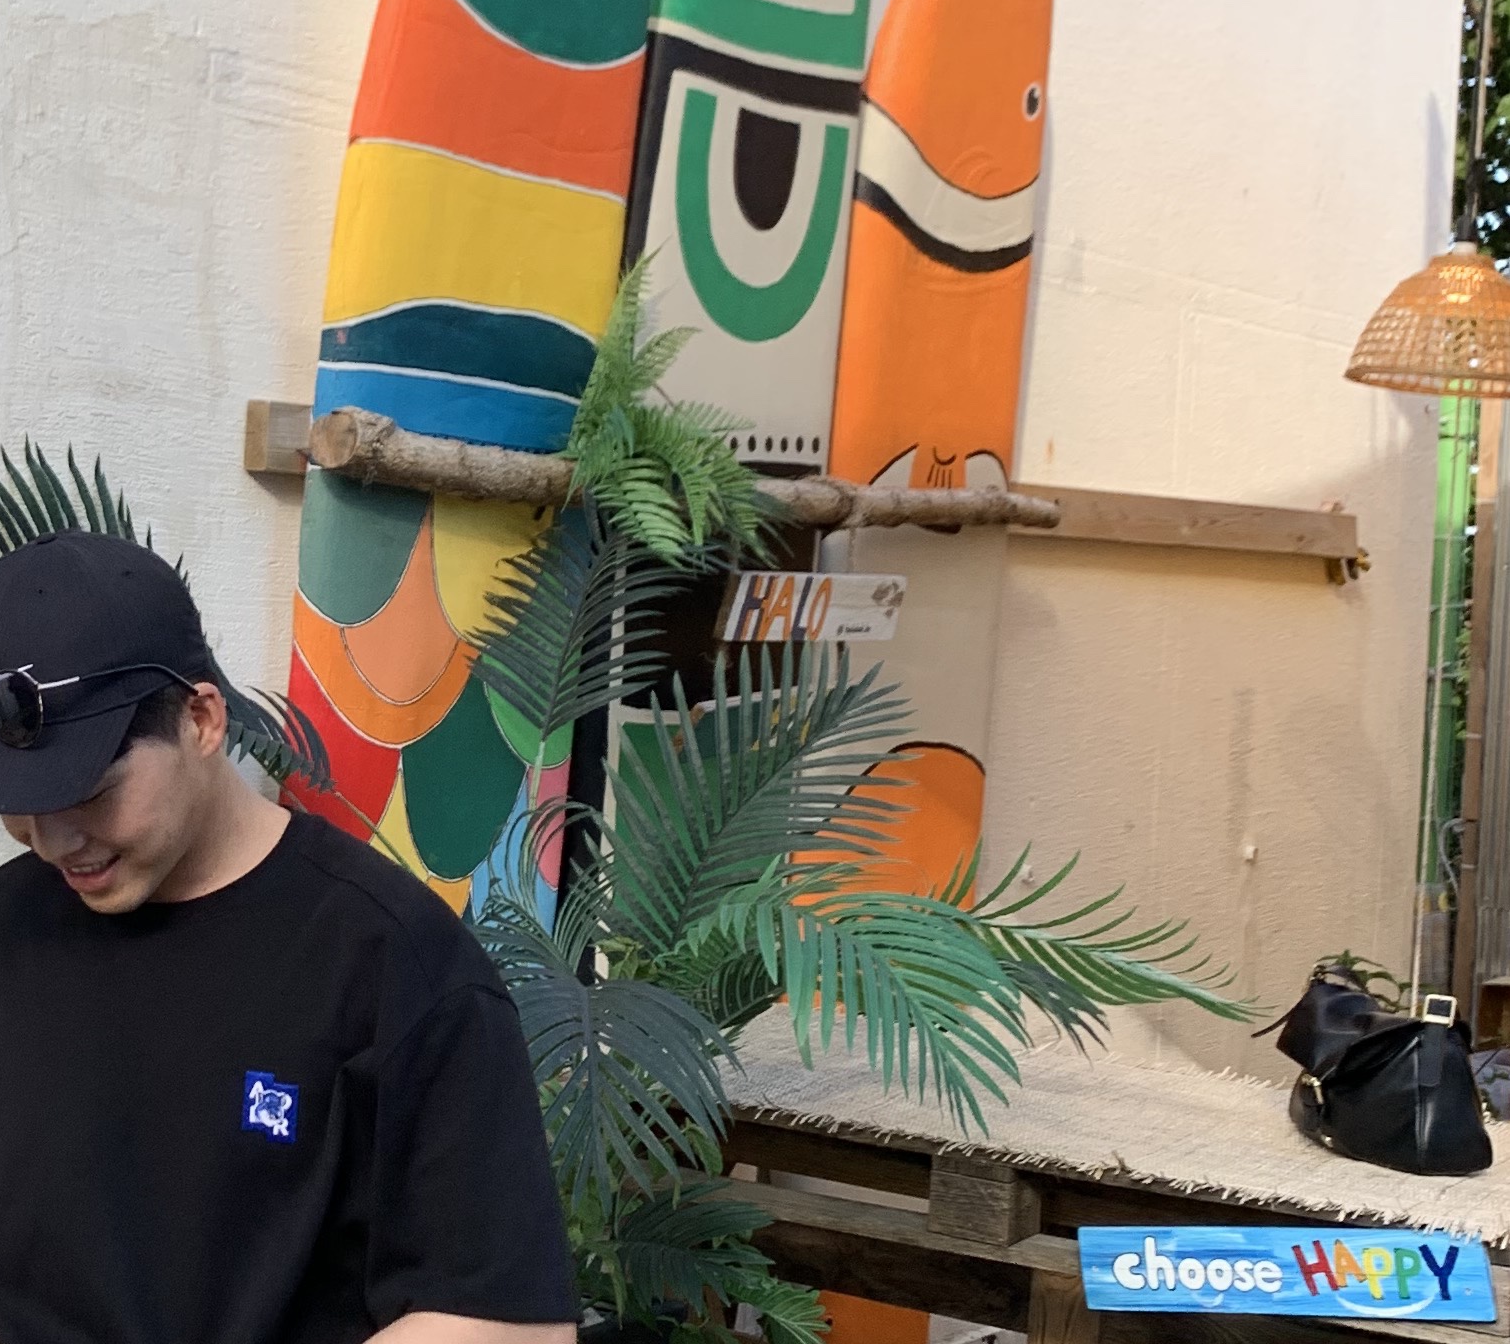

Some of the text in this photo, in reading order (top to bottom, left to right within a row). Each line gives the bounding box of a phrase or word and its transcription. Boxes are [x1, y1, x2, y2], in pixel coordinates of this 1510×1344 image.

[733, 575, 833, 641] HALO
[1112, 1235, 1461, 1301] choose HAPPY
